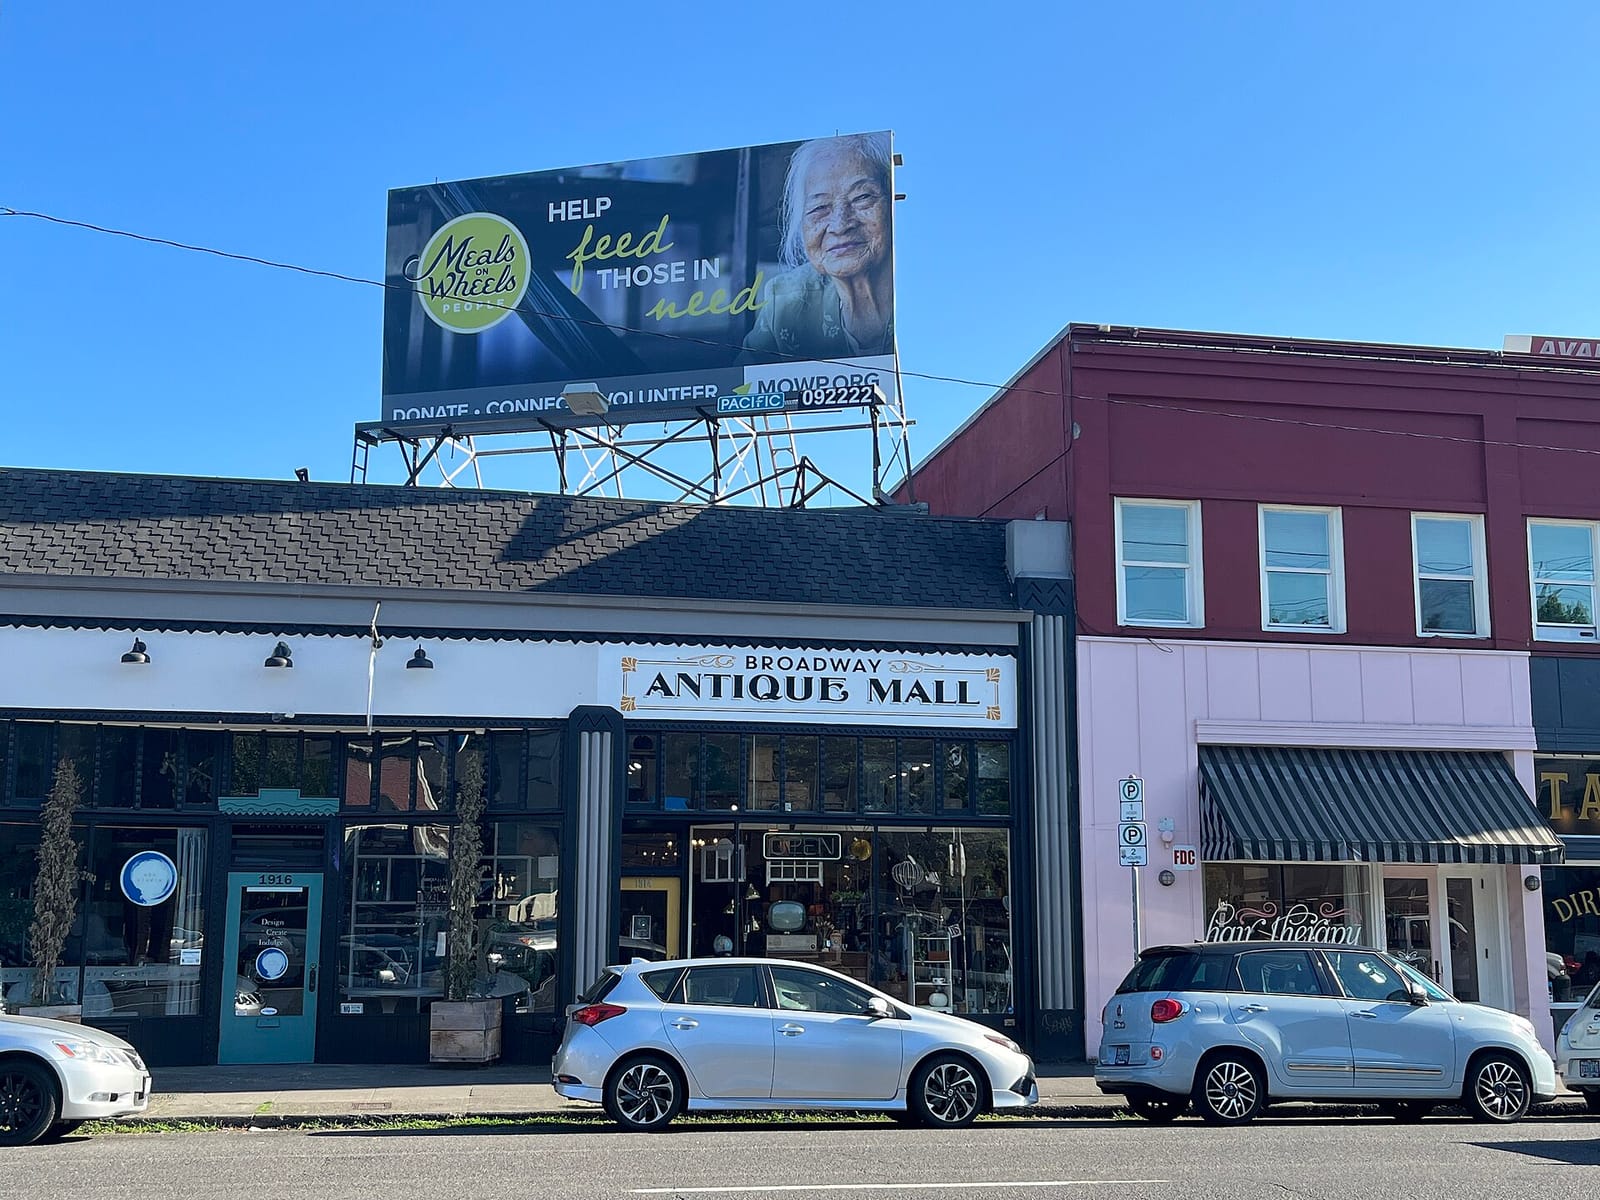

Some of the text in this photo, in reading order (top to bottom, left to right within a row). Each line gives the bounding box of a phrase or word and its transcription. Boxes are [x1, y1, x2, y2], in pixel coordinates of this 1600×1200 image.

[548, 196, 612, 223] HELP
[402, 233, 516, 282] Meals
[565, 213, 675, 296] feed
[475, 268, 489, 276] ON
[596, 257, 720, 290] THOSE IN
[427, 264, 517, 301] Wheels
[442, 298, 505, 314] PEOPLE
[645, 271, 769, 321] need
[758, 372, 880, 394] MOWPORG
[485, 396, 570, 414] CONNEC
[802, 386, 873, 406] 092222
[745, 655, 882, 673] BROADWAY
[644, 671, 980, 706] ANTIQUE MALL
[1127, 785, 1136, 797] P
[1128, 829, 1138, 841] P
[770, 836, 835, 856] OPEN
[1173, 849, 1196, 865] FDC
[258, 874, 293, 885] 1916
[1551, 887, 1600, 923] DIR
[261, 918, 285, 927] Design
[265, 928, 288, 936] Create
[1205, 903, 1267, 943] hair
